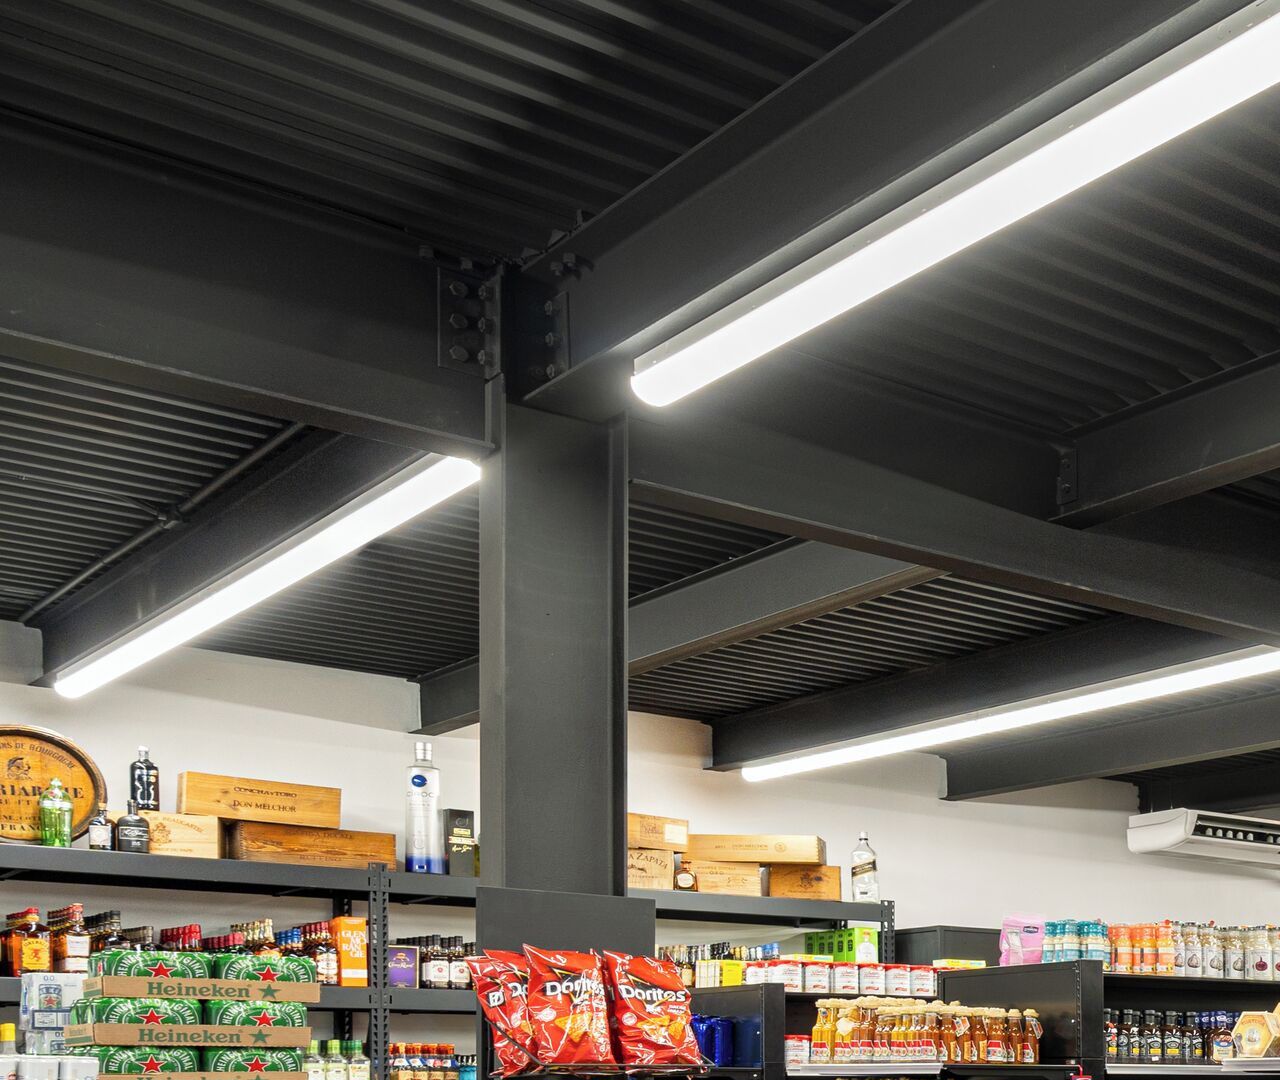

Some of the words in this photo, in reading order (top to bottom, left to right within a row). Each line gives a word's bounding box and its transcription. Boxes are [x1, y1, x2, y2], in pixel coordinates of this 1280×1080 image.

[233, 800, 252, 810] DON
[255, 802, 296, 813] MELCHOR
[636, 851, 669, 870] ZAPATA
[342, 929, 366, 938] GLEN
[342, 943, 360, 951] RAN
[147, 982, 250, 998] Heineken
[619, 985, 686, 1001] Doritos
[138, 1028, 241, 1043] Heineken
